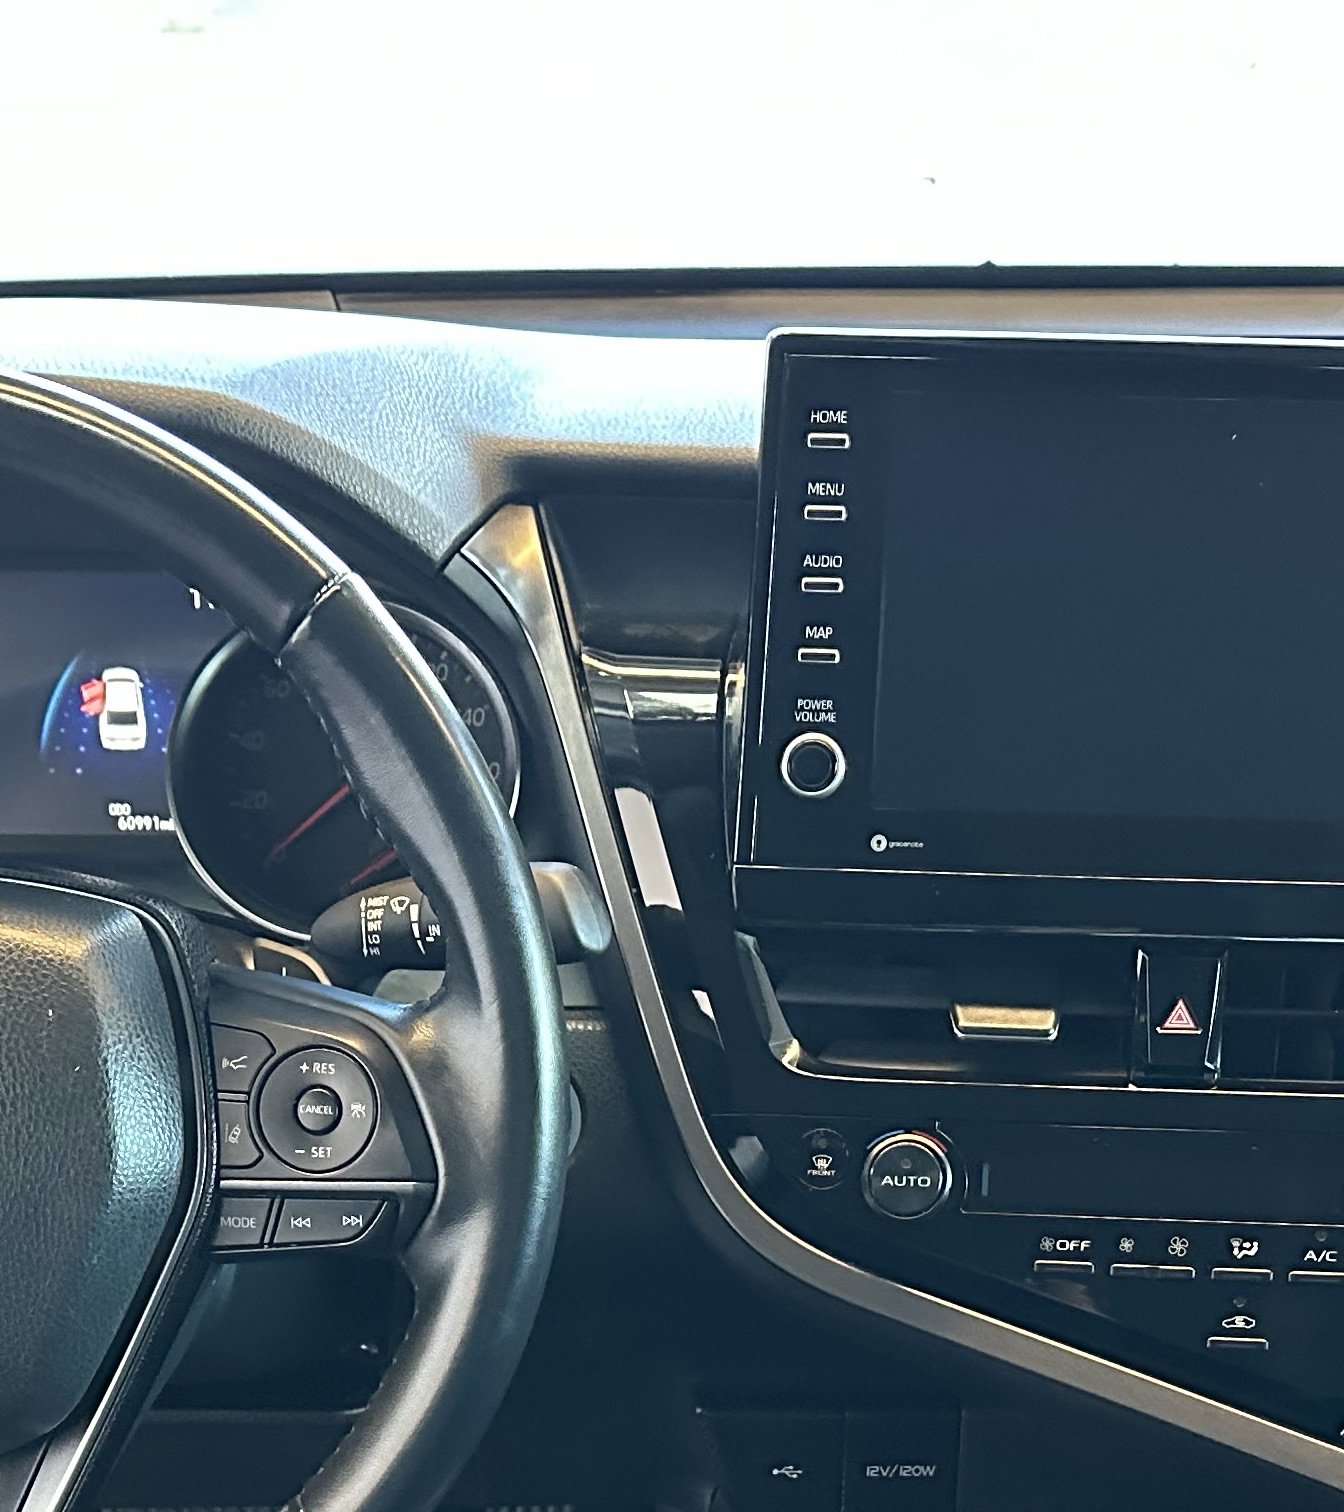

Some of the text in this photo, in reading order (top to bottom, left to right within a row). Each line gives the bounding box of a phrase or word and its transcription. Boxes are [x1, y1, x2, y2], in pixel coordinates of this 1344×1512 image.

[809, 410, 849, 424] HOME
[806, 482, 846, 497] MENU
[803, 554, 843, 568] AUDIO
[804, 625, 834, 640] MAP
[797, 700, 834, 711] POWER
[794, 711, 837, 723] VOLUME
[108, 802, 131, 816] ODO
[367, 896, 389, 907] MIST
[366, 909, 384, 919] OFF
[367, 920, 382, 931] INT
[368, 935, 380, 944] LO
[369, 948, 381, 956] HI
[312, 1062, 336, 1075] RES
[299, 1104, 334, 1116] CANCEL
[311, 1147, 333, 1158] SET
[807, 1169, 836, 1177] FRONT
[881, 1175, 931, 1188] AUTO
[219, 1216, 257, 1230] MODE
[1056, 1238, 1092, 1253] OFF
[1303, 1248, 1338, 1264] A/C
[865, 1464, 936, 1478] 12V/120W
